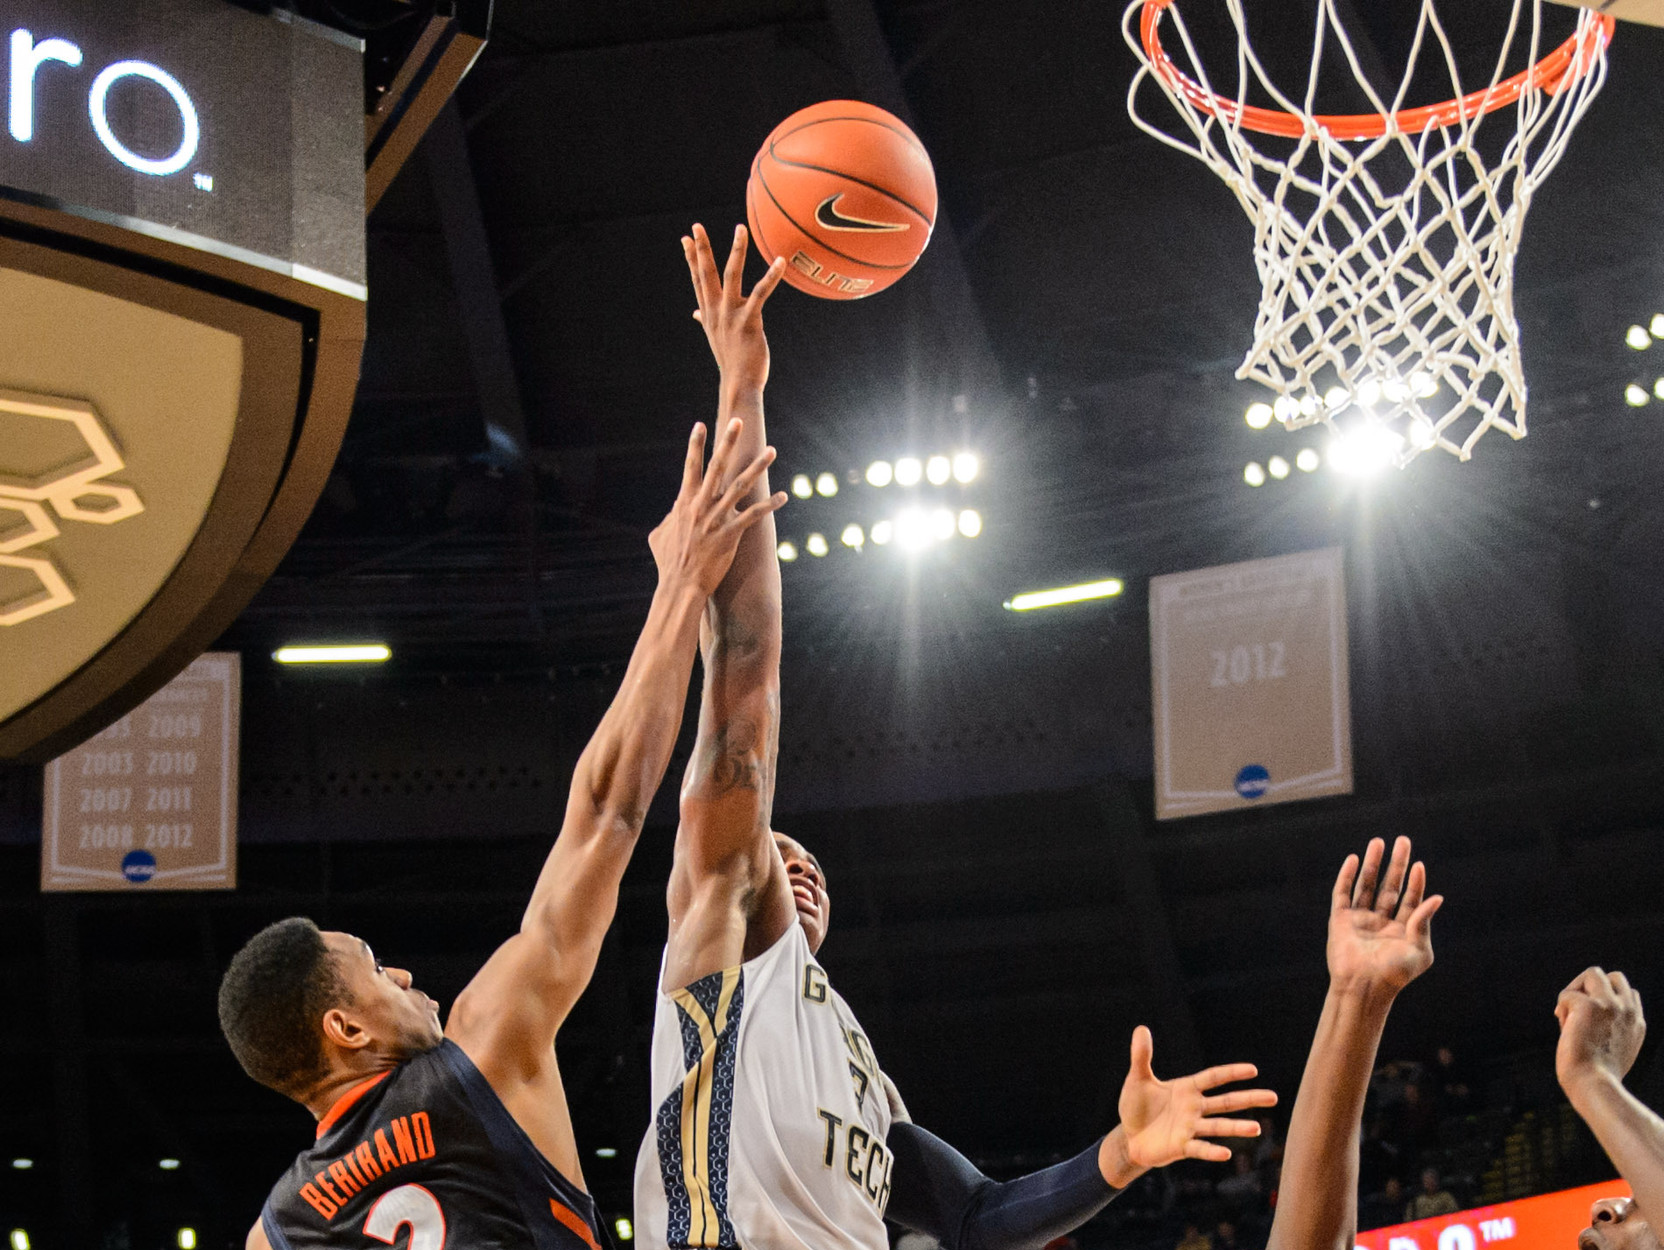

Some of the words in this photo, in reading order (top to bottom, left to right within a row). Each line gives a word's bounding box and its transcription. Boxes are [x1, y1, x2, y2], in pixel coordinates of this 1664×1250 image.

[790, 249, 875, 293] ELITE
[1209, 640, 1286, 687] 2012
[144, 823, 193, 849] 2012
[299, 1111, 436, 1221] BERTRAND
